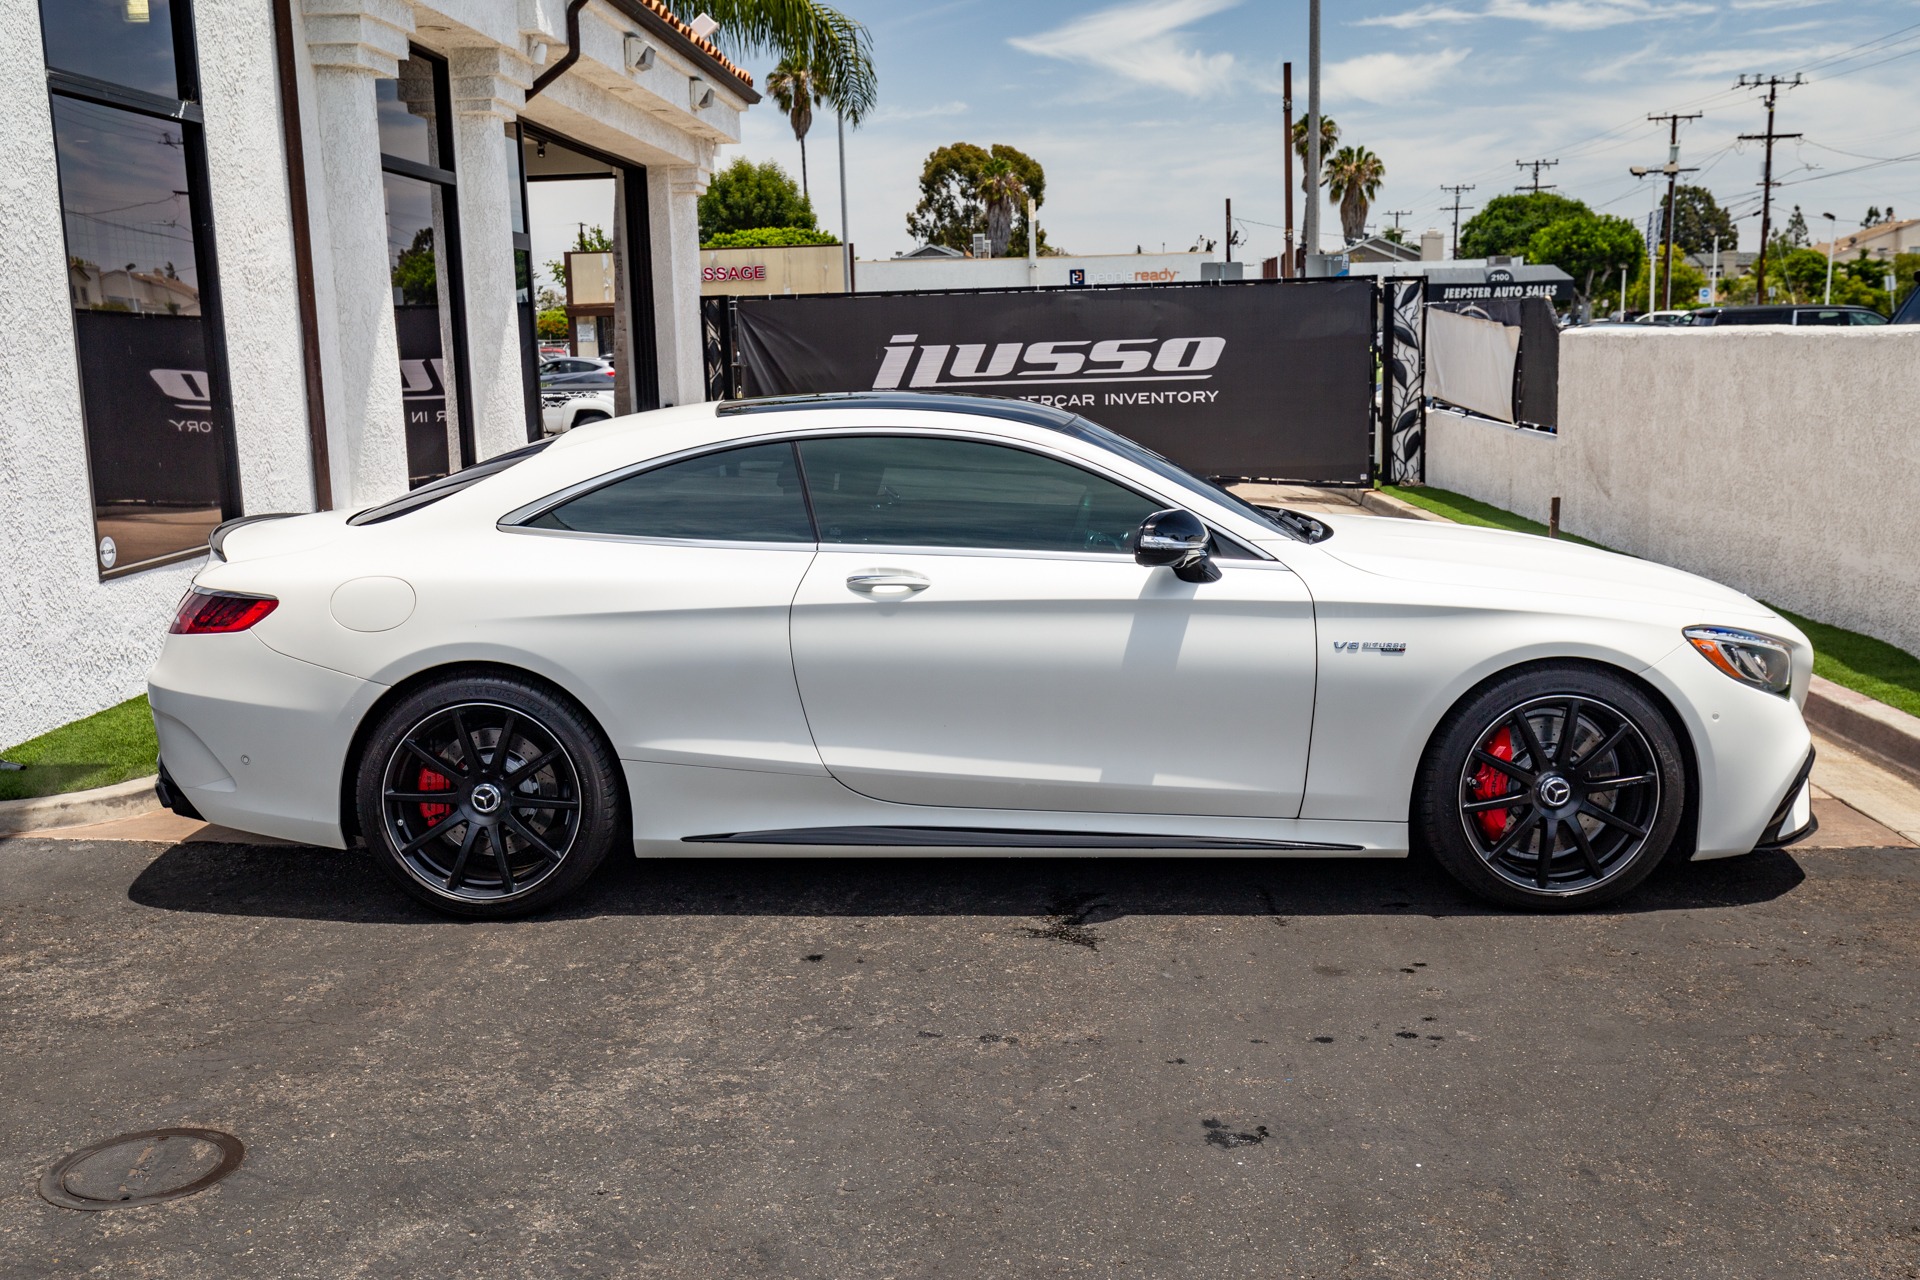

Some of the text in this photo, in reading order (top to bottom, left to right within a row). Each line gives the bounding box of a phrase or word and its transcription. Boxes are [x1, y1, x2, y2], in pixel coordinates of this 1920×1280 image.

[701, 265, 766, 282] SSAGE
[1490, 273, 1510, 281] 2100
[1443, 284, 1558, 299] JEEPSTER AUTO SALES
[1104, 390, 1219, 406] INVENTORY
